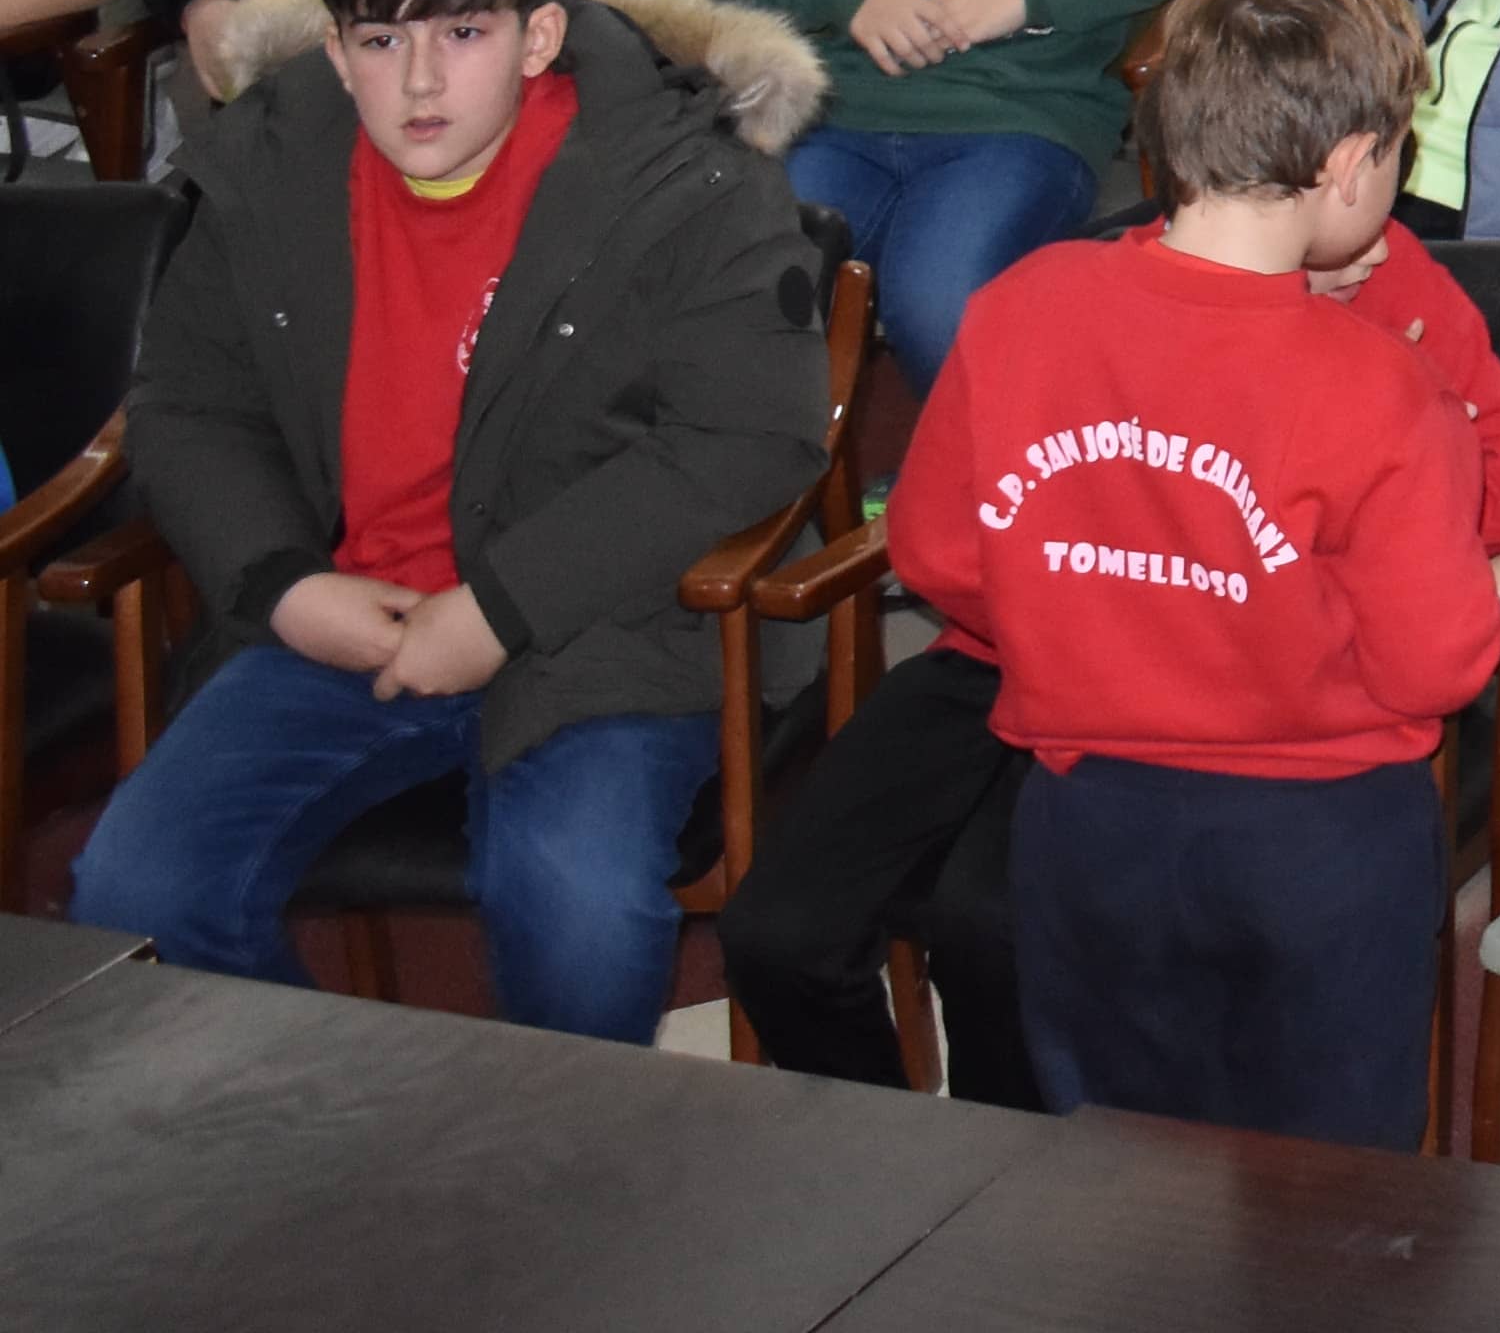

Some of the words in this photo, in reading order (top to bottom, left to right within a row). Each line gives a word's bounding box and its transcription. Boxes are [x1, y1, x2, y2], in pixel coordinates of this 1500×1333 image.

[979, 472, 1037, 531] C.P.
[1026, 429, 1082, 480] SAN
[1081, 415, 1145, 463] JOSÉ
[1147, 429, 1189, 473] DE
[1191, 443, 1300, 574] CALASANZ
[1042, 540, 1249, 604] TOMELLOSO
